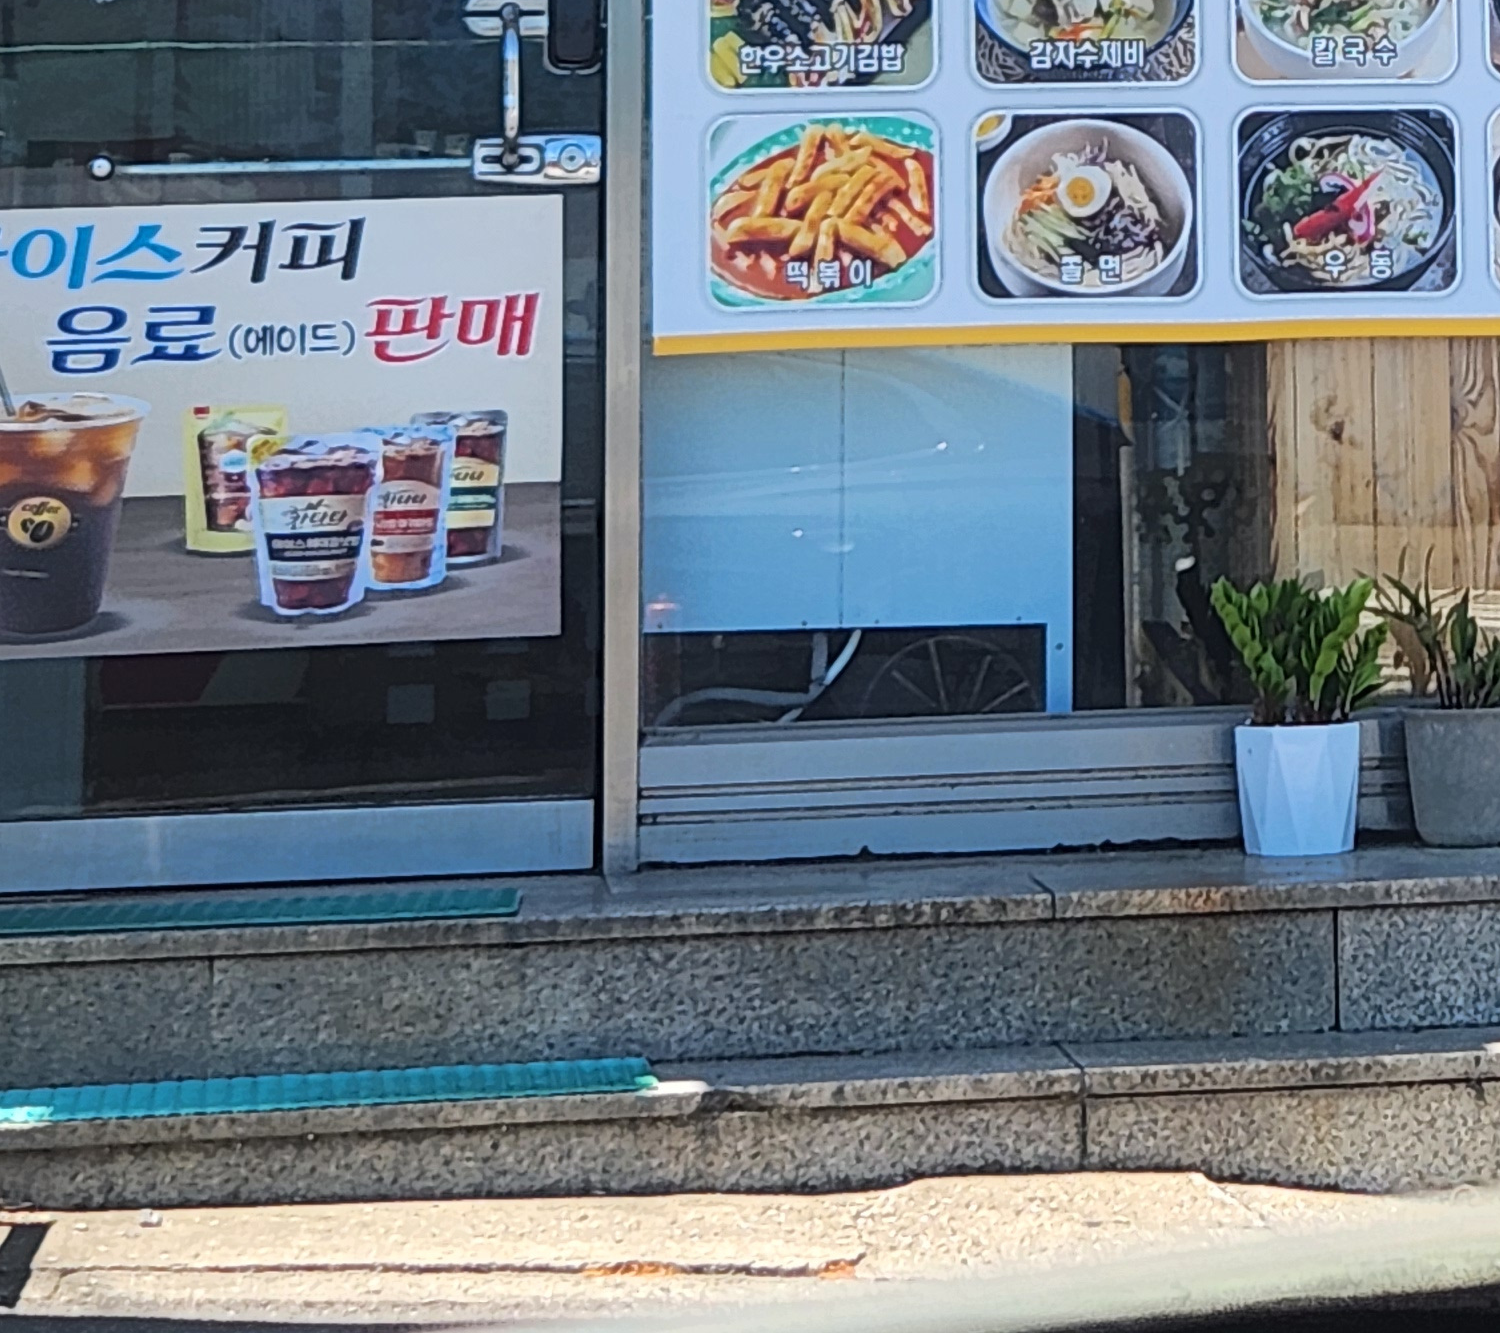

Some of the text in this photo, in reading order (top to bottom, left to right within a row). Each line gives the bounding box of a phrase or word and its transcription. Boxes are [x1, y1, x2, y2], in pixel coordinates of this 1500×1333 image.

[738, 42, 907, 75] 한우소고기김밥
[1029, 39, 1147, 71] 감자수제비
[1311, 36, 1399, 67] 칼국수
[0, 217, 367, 290] 이스커피
[1322, 249, 1393, 279] 우동
[785, 258, 874, 289] 떡볶이
[46, 291, 541, 375] 음료 (에이드) 판매
